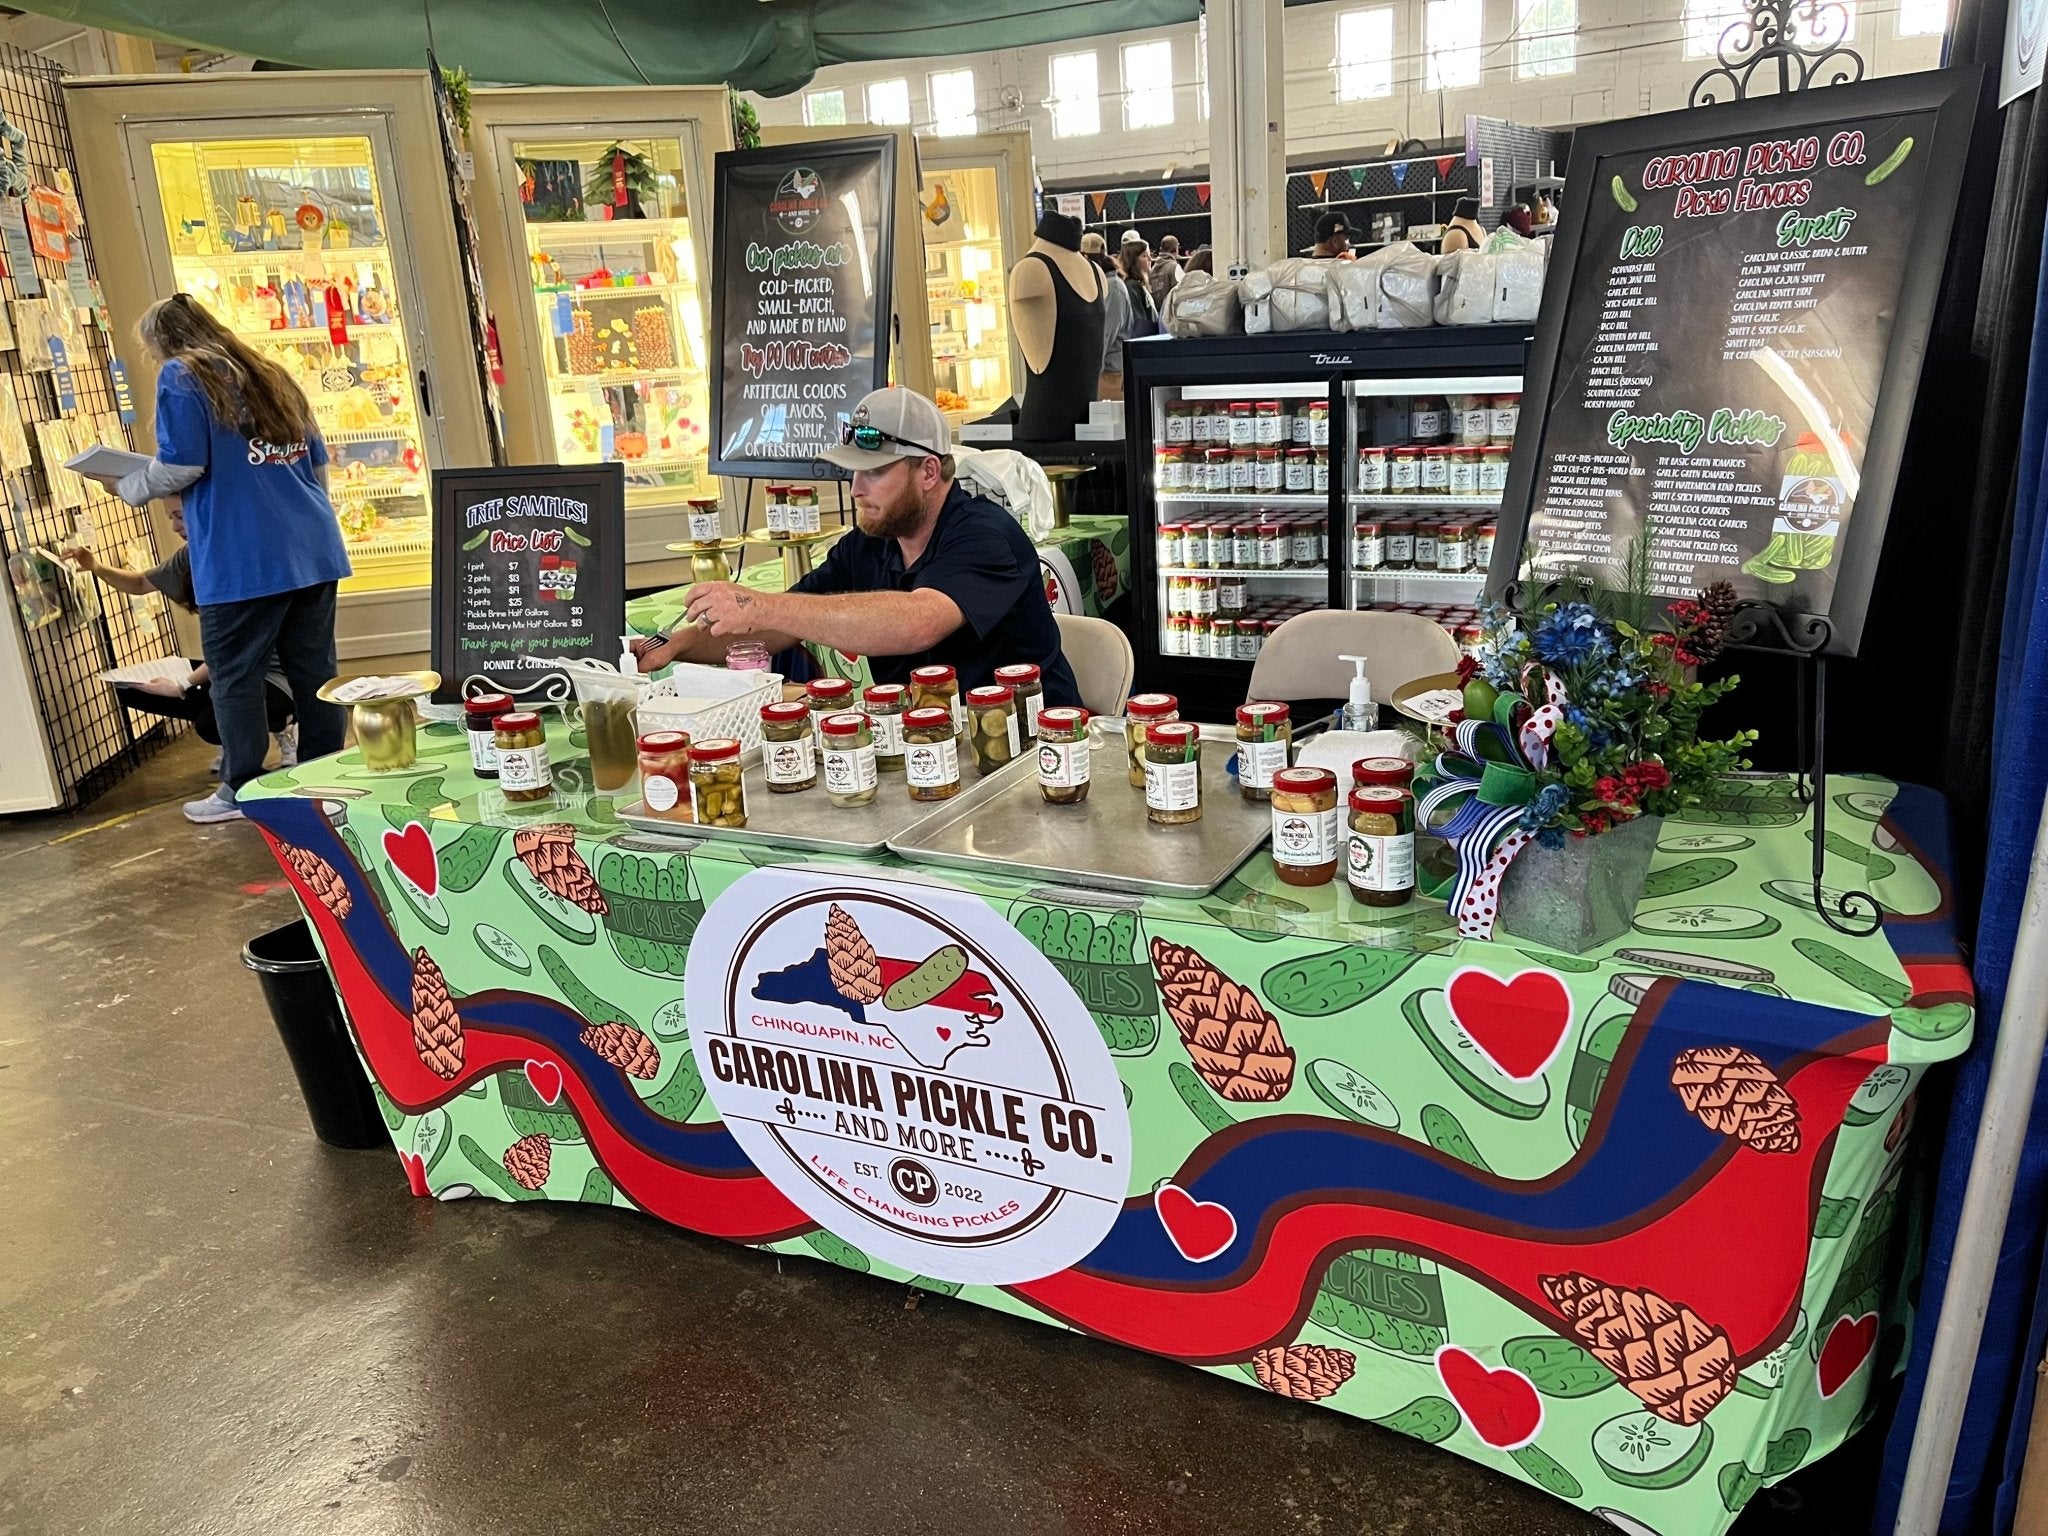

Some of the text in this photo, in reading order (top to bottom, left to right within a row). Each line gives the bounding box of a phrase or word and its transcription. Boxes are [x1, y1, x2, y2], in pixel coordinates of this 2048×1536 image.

[1828, 131, 1866, 167] CO.
[1776, 207, 1856, 248] Sweet
[1620, 225, 1662, 260] Dill
[746, 243, 773, 272] Our
[773, 241, 824, 276] pickles
[760, 278, 834, 295] COLD-PACKED,
[758, 298, 835, 315] SMALL-BATCH,
[747, 317, 846, 334] AND MADE BY HAND
[766, 341, 784, 370] DO
[743, 384, 846, 399] ARTIFICIAL COLORS
[780, 404, 826, 421] LAVORS,
[793, 423, 826, 440] SYRUP,
[1608, 407, 1786, 455] Specialty Pickles
[745, 442, 759, 456] OR
[466, 496, 587, 528] FREE SAMPLES!
[1681, 504, 1701, 514] COOL
[1698, 517, 1718, 527] COOL
[491, 529, 564, 552] Price List
[471, 562, 484, 571] pint
[509, 562, 518, 570] $7
[468, 574, 519, 583] 2 pints $13
[468, 586, 473, 594] 3
[474, 586, 491, 595] pints
[474, 598, 490, 607] pints
[509, 598, 522, 606] $25
[508, 609, 523, 617] Half
[571, 607, 583, 615] $10
[468, 622, 490, 631] Bloody
[493, 622, 511, 630] Mary
[513, 621, 525, 629] Mix
[527, 620, 541, 628] Half
[571, 619, 582, 627] $13
[461, 634, 593, 653] Thank you for your business!
[484, 660, 523, 670] DONNIE &
[1055, 963, 1143, 1011] KLES
[751, 1014, 895, 1050] CHINQUAPIN, NC
[708, 1039, 1113, 1164] CAROLINA PICKLE CO.
[835, 1111, 977, 1163] AND MORE
[810, 1154, 1020, 1229] LIFE CHANGING PICKLES
[854, 1162, 983, 1203] EST. CP 2022
[1320, 1256, 1431, 1320] CKLES
